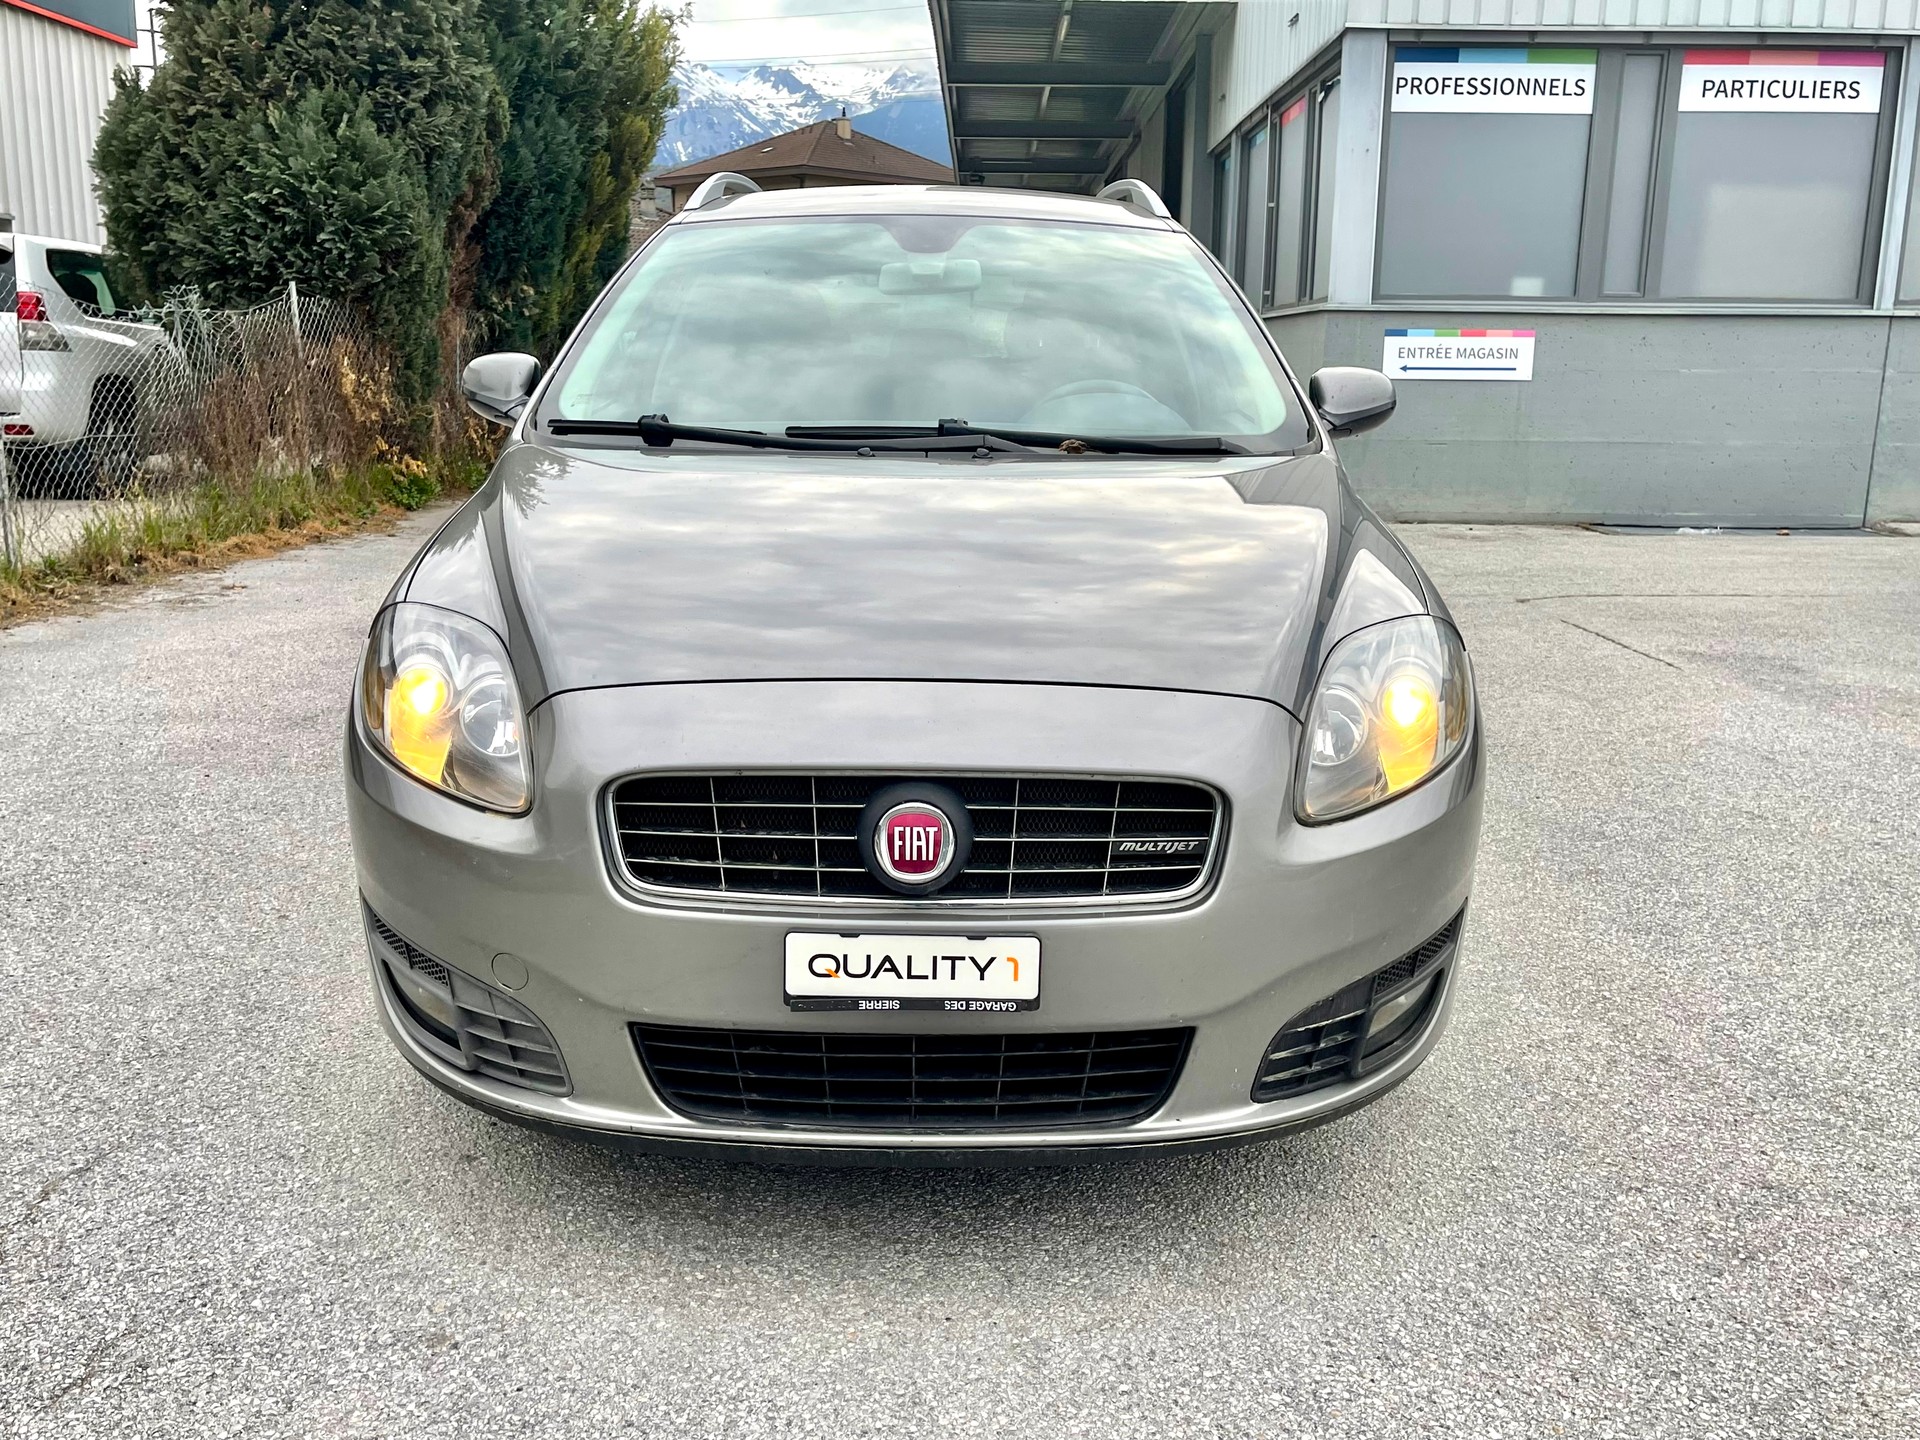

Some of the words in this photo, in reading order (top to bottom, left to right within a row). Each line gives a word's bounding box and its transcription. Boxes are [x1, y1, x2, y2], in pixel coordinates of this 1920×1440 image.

[1395, 76, 1586, 97] PROFESSIONNELS
[1702, 79, 1861, 100] PARTICULIERS
[1398, 344, 1452, 359] ENTRÉE
[1456, 347, 1519, 360] MAGASIN
[893, 826, 939, 861] FIAT
[1119, 841, 1199, 854] MULTIJET
[808, 953, 997, 981] QUALITY
[1006, 957, 1019, 982] 1
[858, 1000, 900, 1010] SIERRE
[944, 1001, 967, 1011] DES
[969, 1001, 1017, 1012] GARAGE
